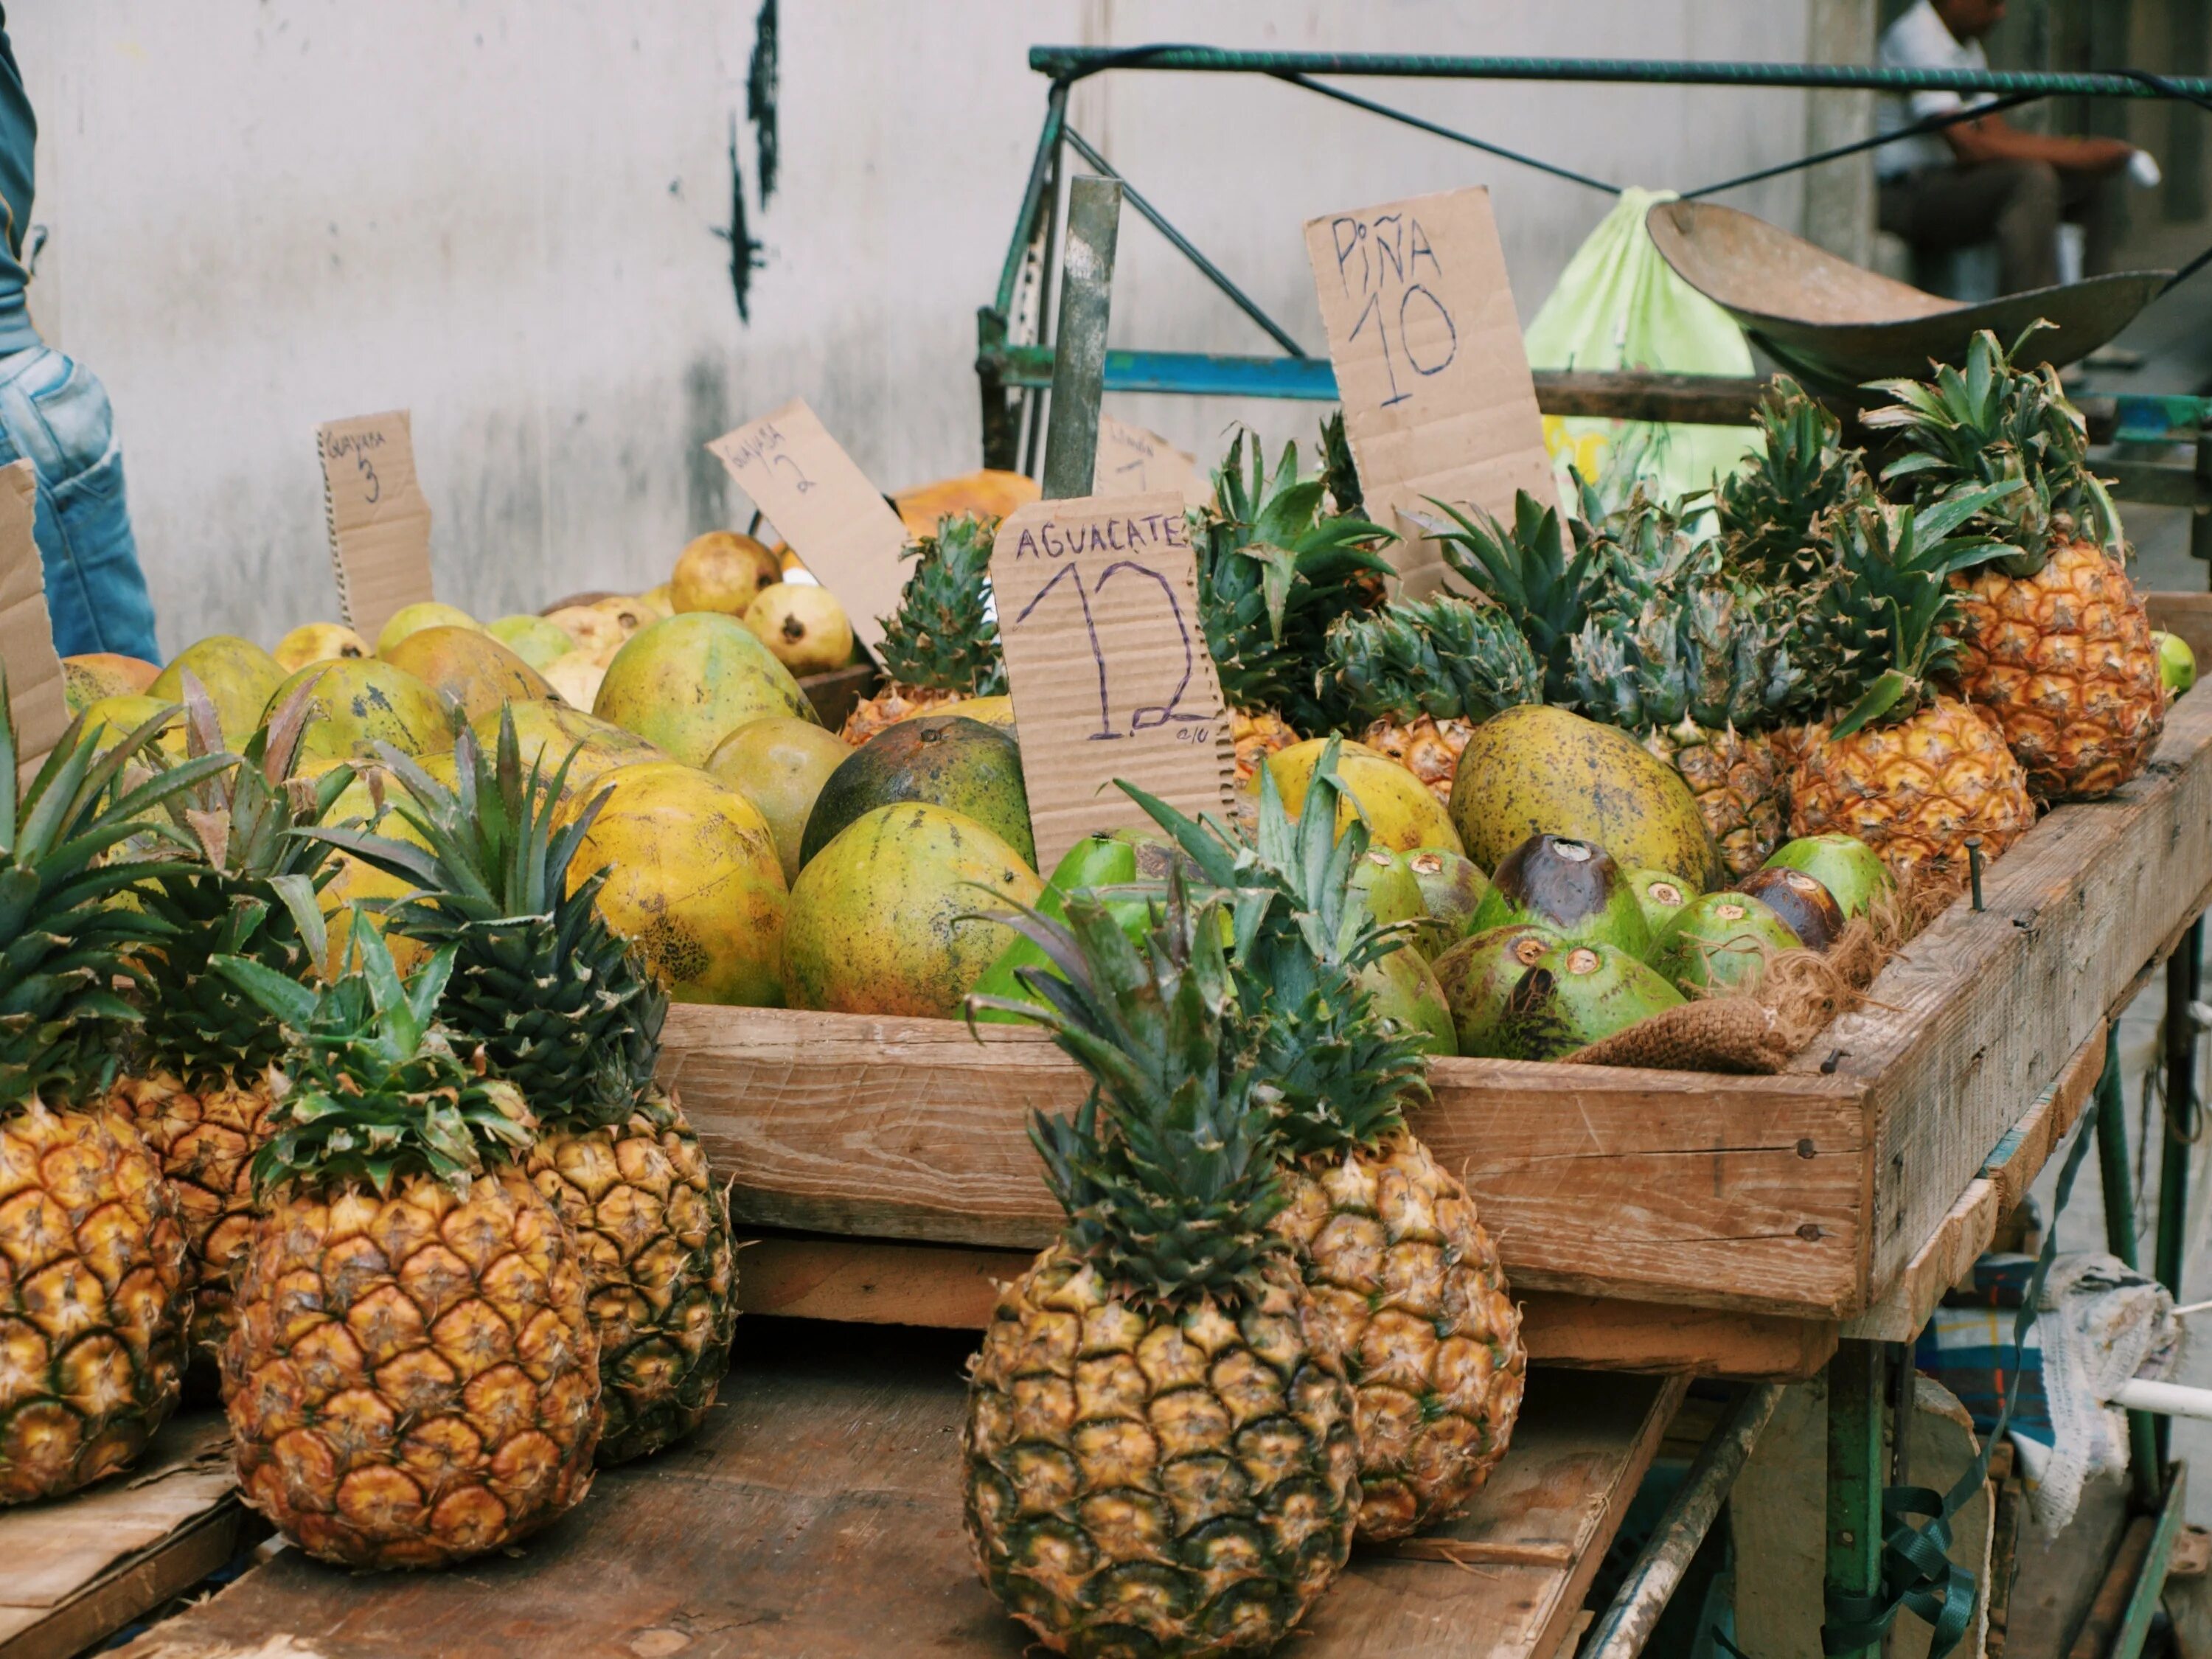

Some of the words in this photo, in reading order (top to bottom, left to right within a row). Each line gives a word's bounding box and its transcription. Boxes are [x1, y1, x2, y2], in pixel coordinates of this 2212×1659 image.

[1349, 283, 1457, 408] 10
[358, 457, 379, 504] 3
[773, 453, 818, 495] 2
[1016, 514, 1186, 560] AGUACATE
[1015, 560, 1216, 740] 12
